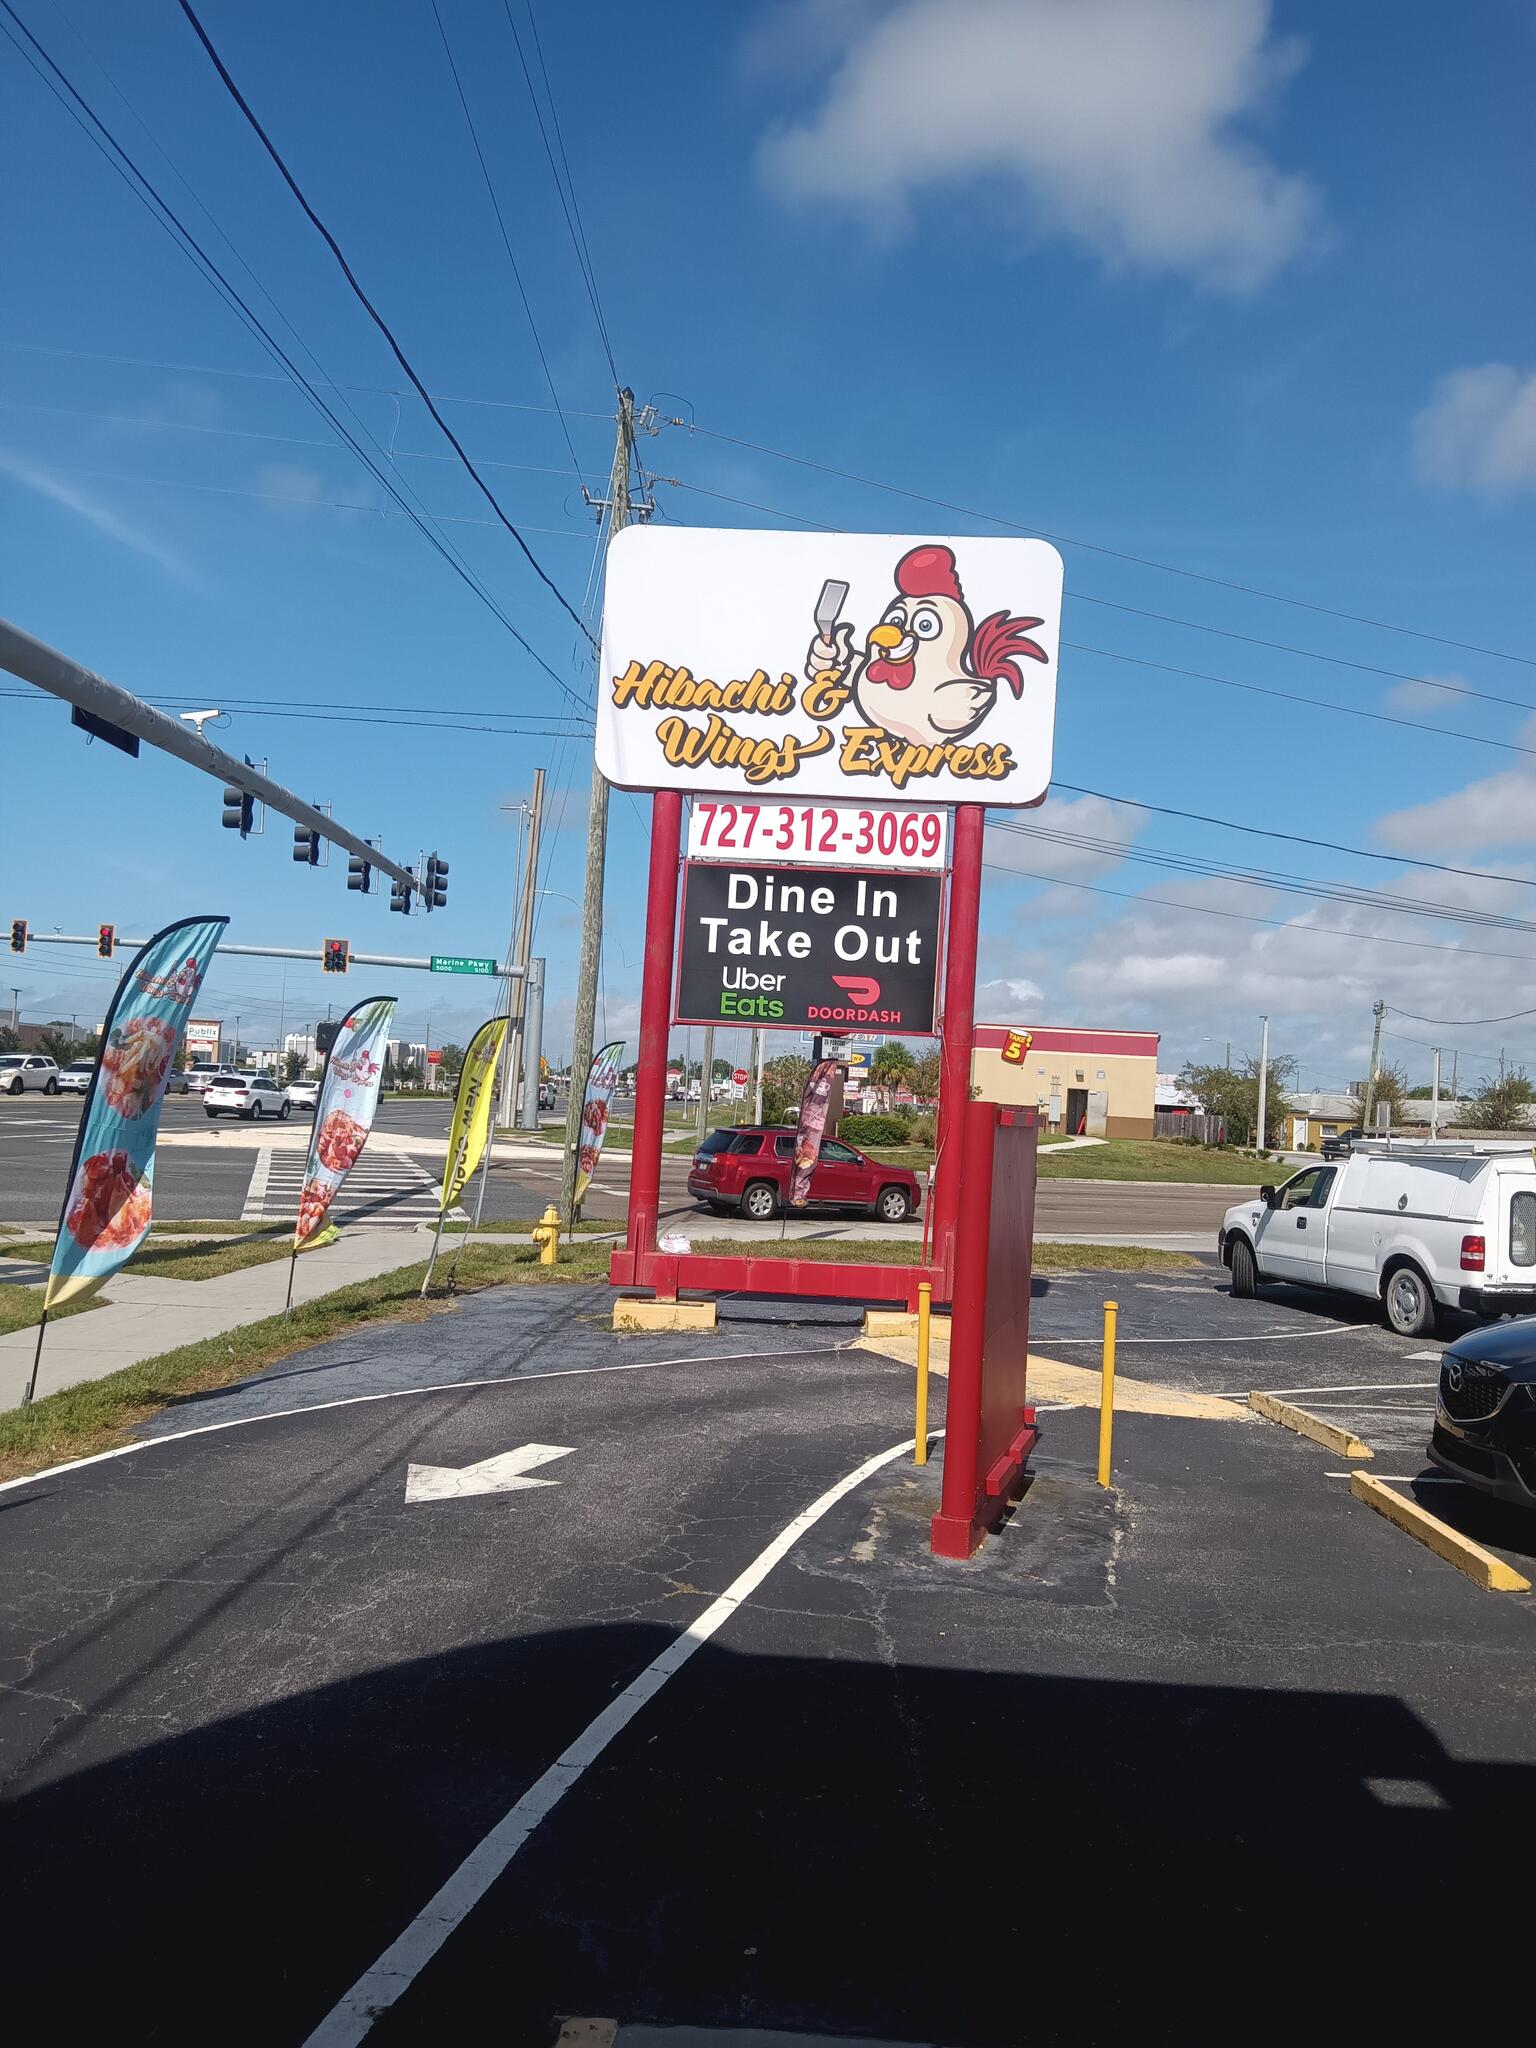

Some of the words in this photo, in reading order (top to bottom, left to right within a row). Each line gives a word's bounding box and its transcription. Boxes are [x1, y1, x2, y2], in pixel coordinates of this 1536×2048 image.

[612, 659, 797, 716] Hibachi
[801, 668, 850, 721] &
[655, 713, 836, 786] Wings
[838, 725, 1018, 790] Express
[698, 803, 942, 858] 727-312-3069
[727, 873, 836, 915] Dine
[856, 880, 898, 918] In
[700, 917, 812, 959] Take
[834, 925, 922, 965] Out
[435, 958, 465, 967] Marine
[468, 960, 489, 969] Pkwy
[722, 966, 786, 991] Uber
[720, 991, 784, 1018] Eats
[808, 1006, 901, 1023] DOORDASH
[189, 1027, 217, 1035] Publix
[1008, 1032, 1026, 1044] TAKE
[1005, 1041, 1021, 1059] 5
[733, 1072, 748, 1081] STOP
